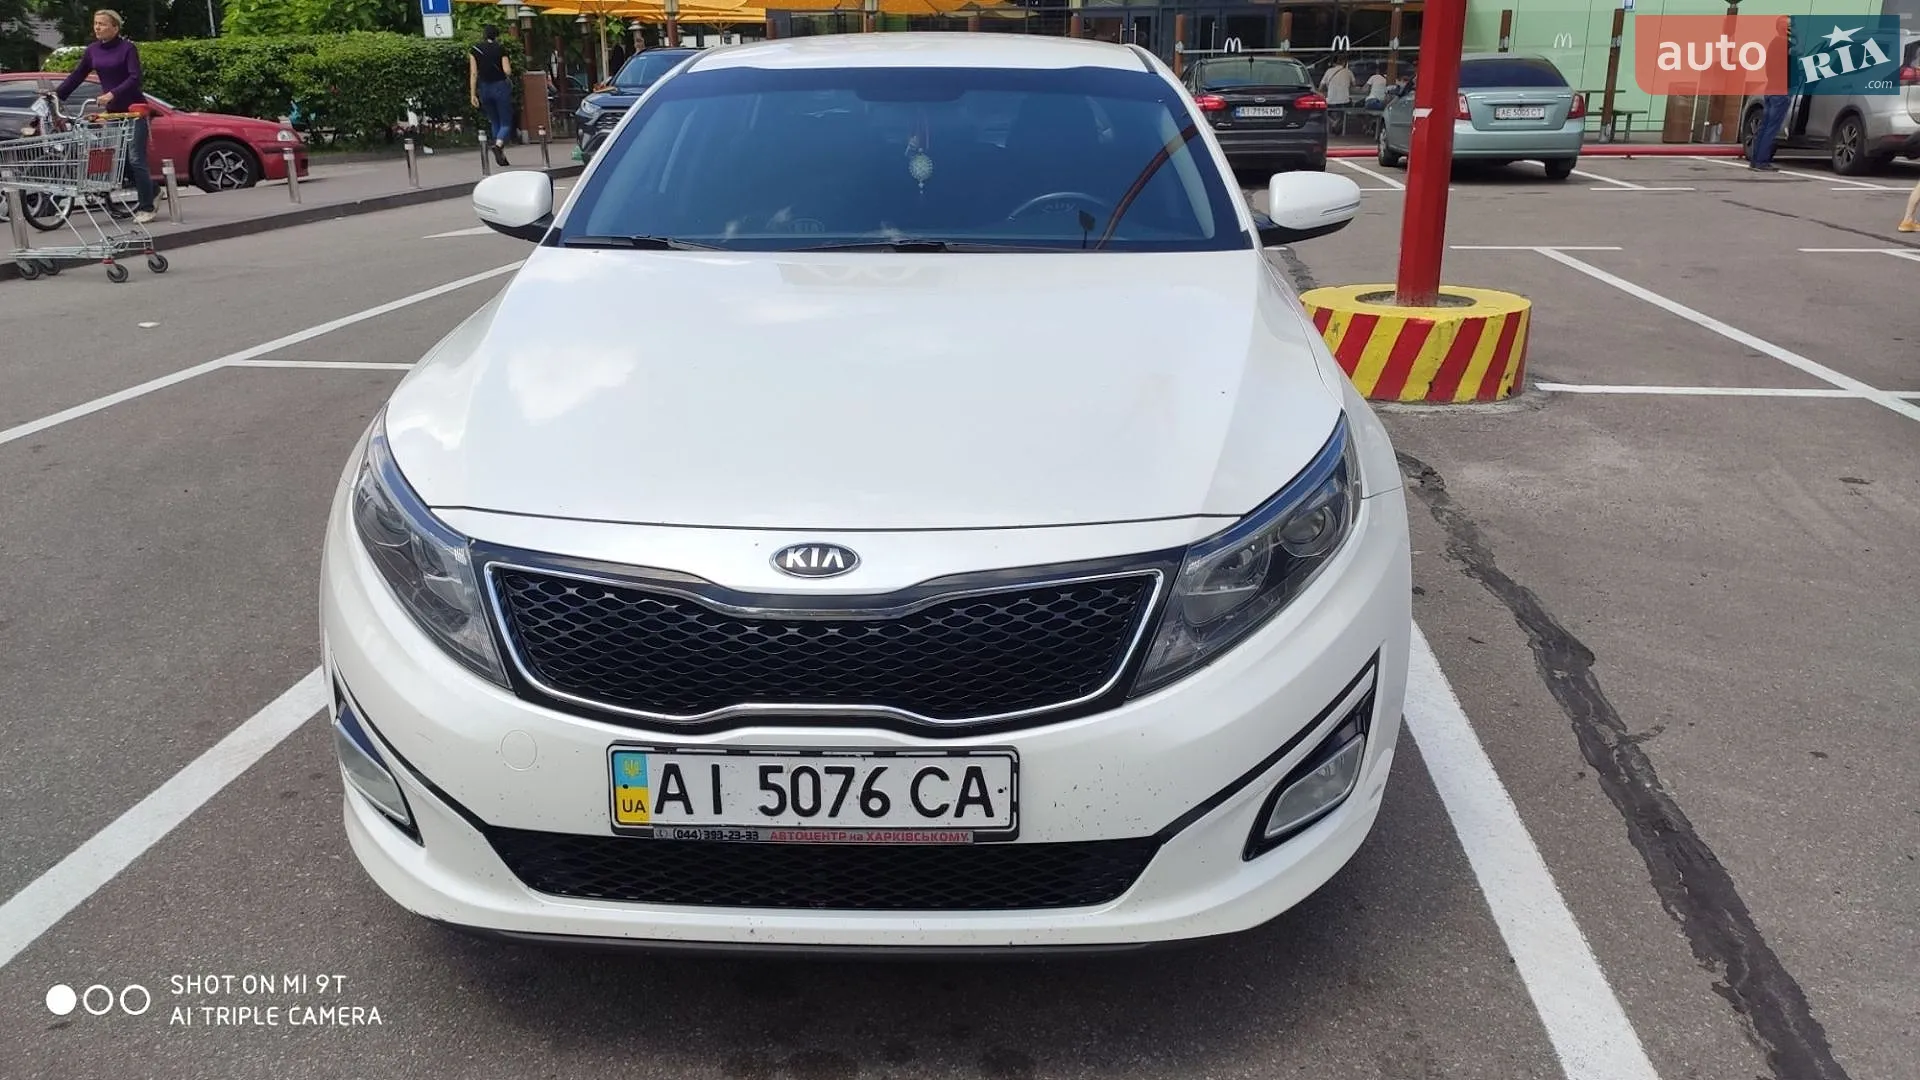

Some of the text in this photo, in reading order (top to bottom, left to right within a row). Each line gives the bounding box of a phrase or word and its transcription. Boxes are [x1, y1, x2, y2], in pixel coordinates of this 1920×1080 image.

[785, 547, 845, 568] KIA
[654, 763, 995, 818] AI 5076 CA
[622, 799, 647, 814] UA
[770, 831, 846, 842] АВТОЦЕНТР
